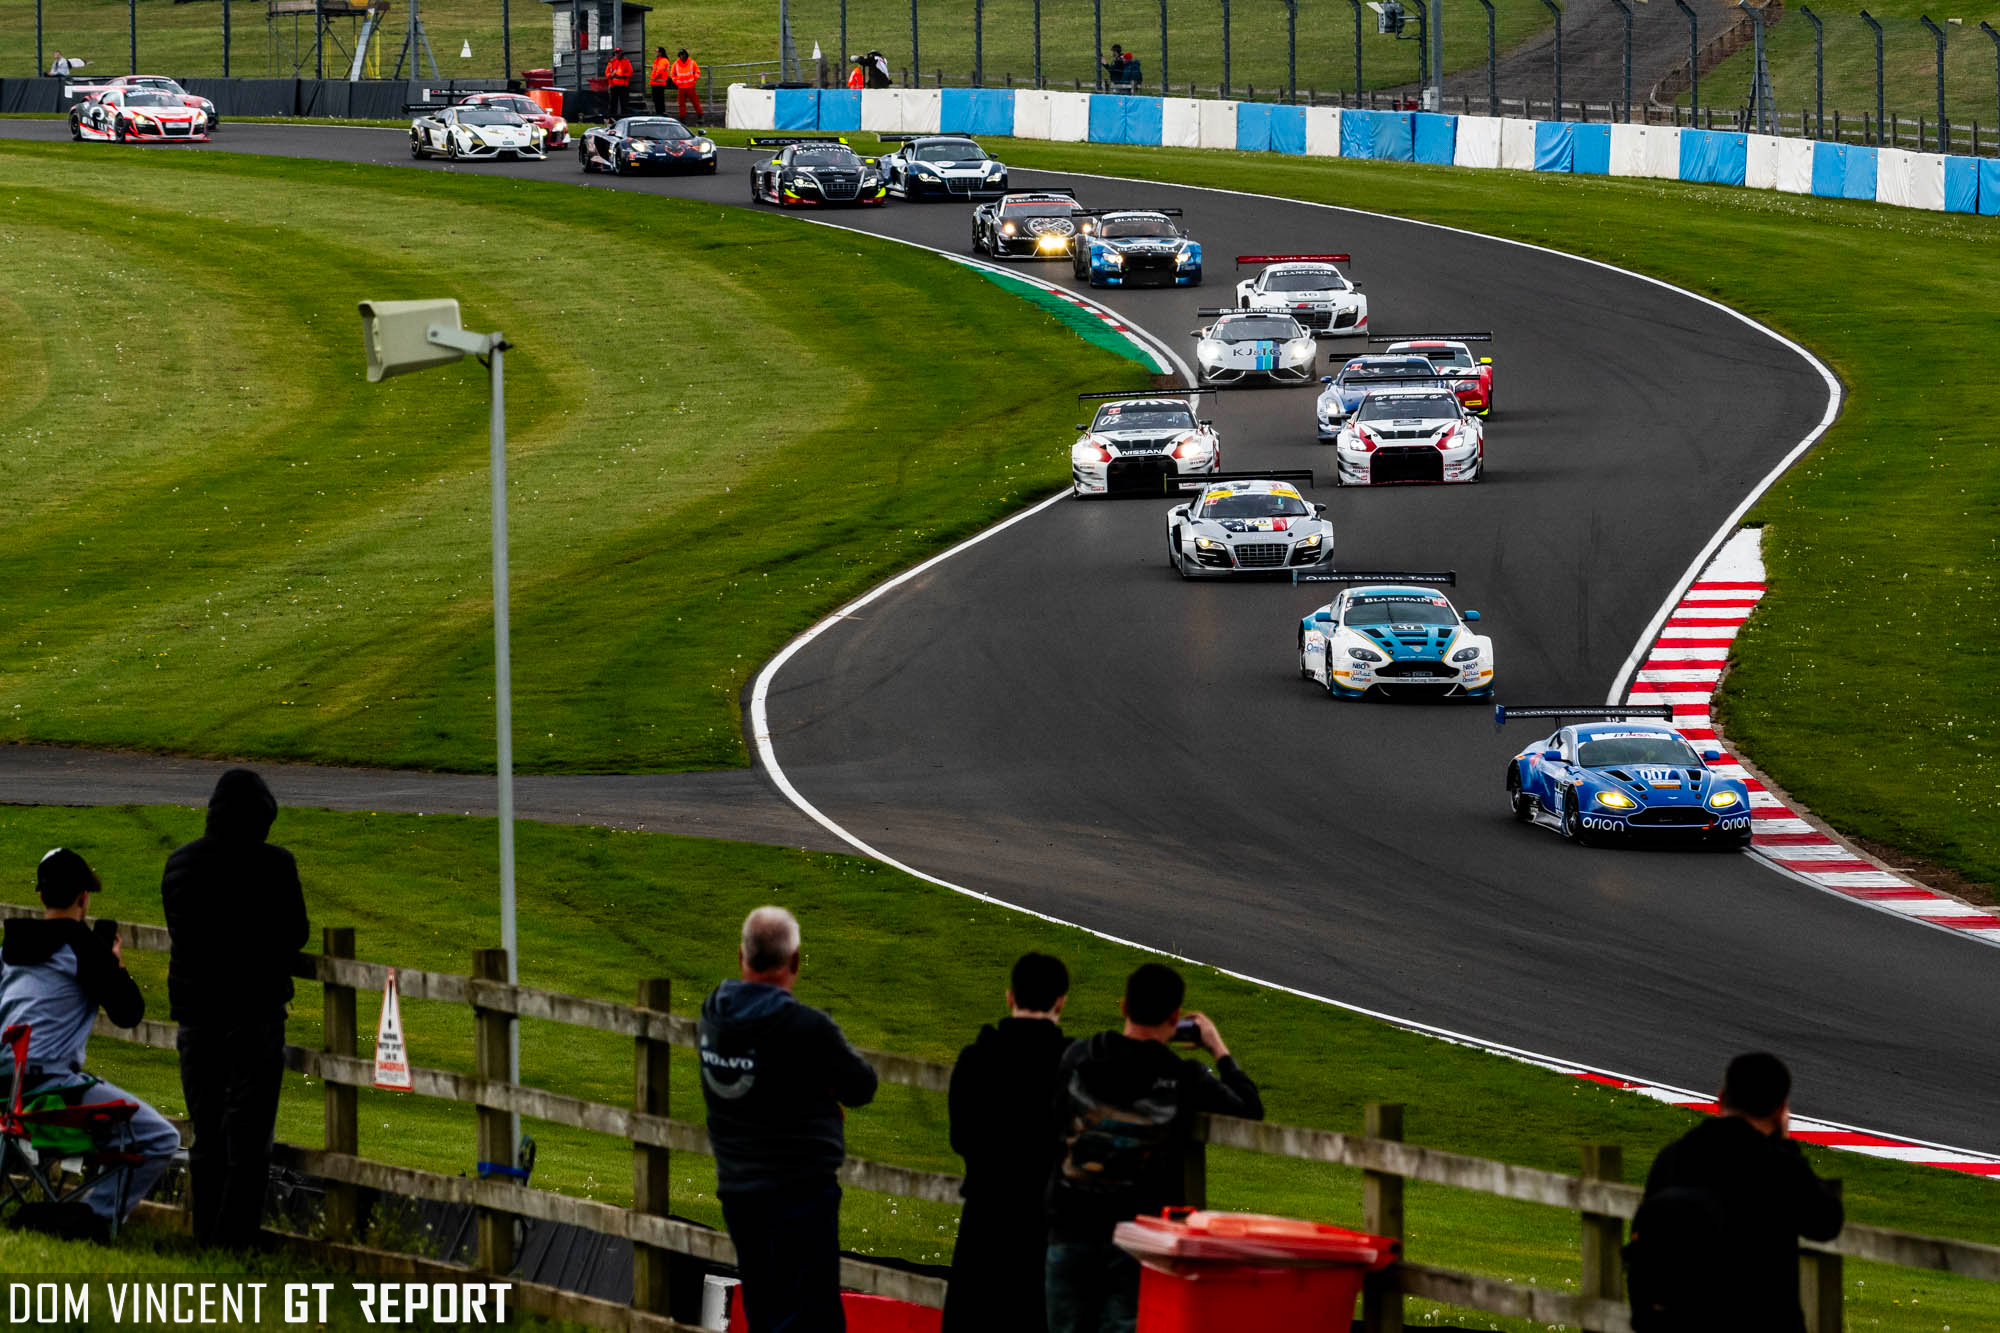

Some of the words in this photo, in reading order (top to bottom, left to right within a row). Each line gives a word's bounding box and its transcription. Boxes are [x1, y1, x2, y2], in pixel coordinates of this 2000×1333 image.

[1640, 768, 1672, 780] 007
[1582, 817, 1625, 832] orion
[1721, 816, 1751, 831] orion
[702, 1051, 754, 1070] VOLVO
